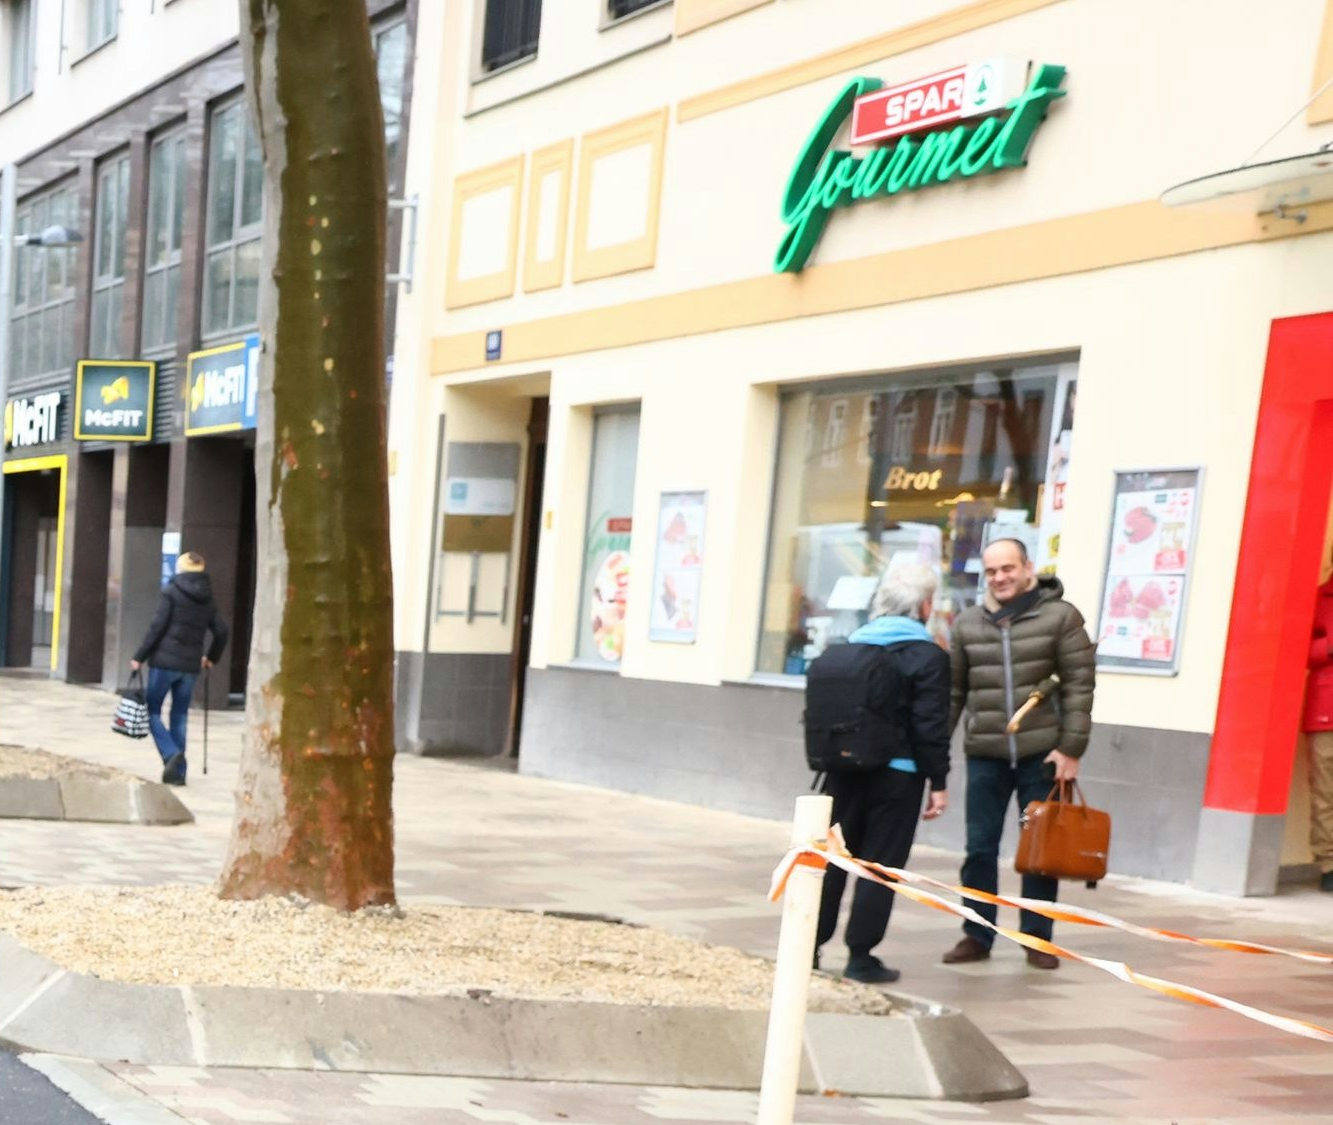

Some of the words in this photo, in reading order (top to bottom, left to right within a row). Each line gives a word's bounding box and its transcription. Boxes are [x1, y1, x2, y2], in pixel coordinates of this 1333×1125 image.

[885, 78, 965, 127] SPAR
[774, 64, 1065, 273] Gourmet
[12, 391, 61, 447] McFIT
[85, 409, 143, 427] McFIT
[884, 466, 942, 491] Brot
